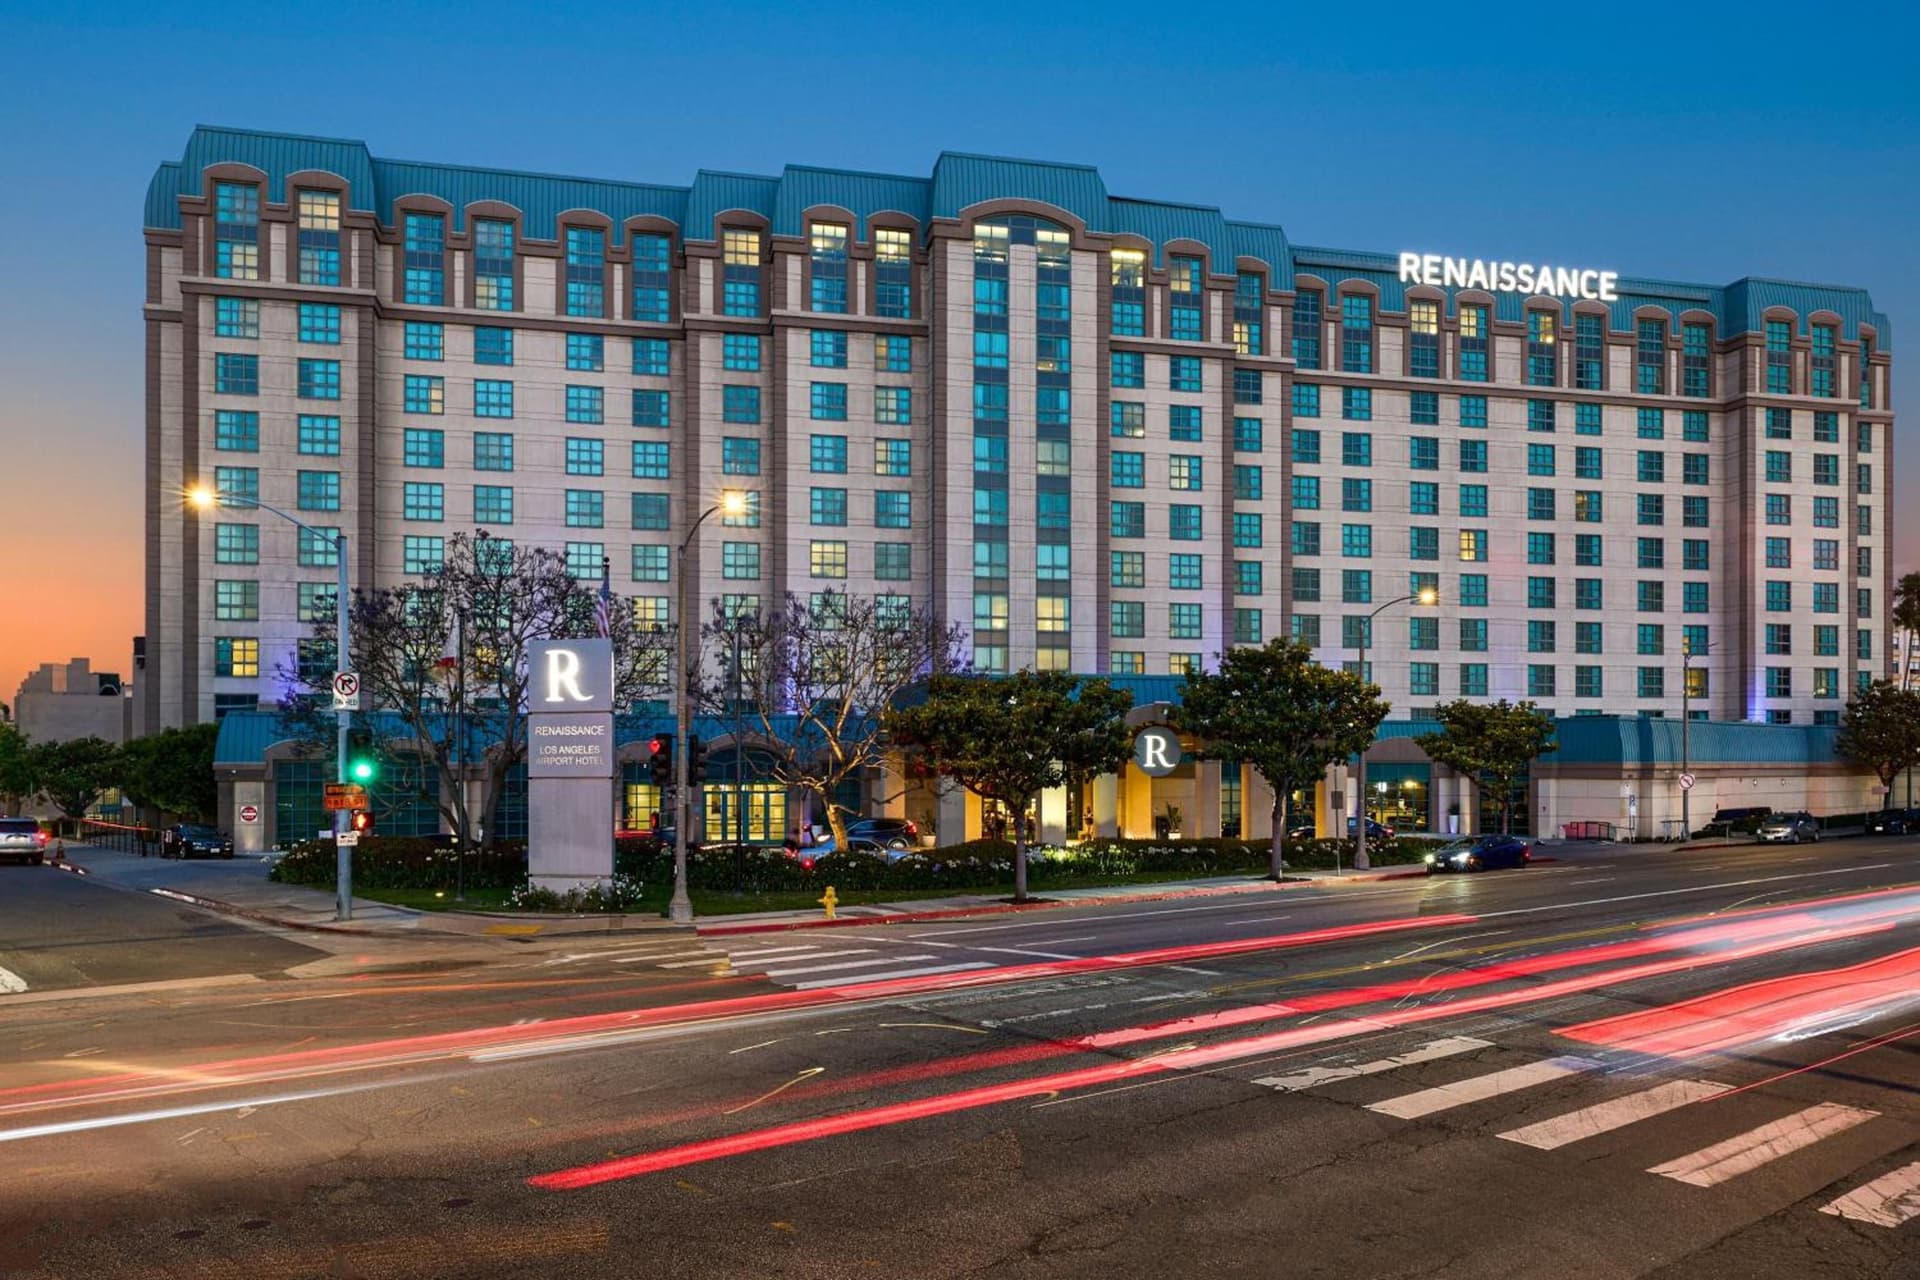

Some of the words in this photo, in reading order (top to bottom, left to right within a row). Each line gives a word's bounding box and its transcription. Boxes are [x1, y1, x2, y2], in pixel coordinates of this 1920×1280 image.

[1400, 252, 1618, 300] RENAISSANCE
[545, 649, 594, 702] R
[535, 725, 605, 736] RENAISSANCE
[540, 745, 557, 755] LOS
[559, 745, 600, 755] ANGELES
[576, 756, 604, 766] HOTEL
[1143, 735, 1176, 768] R
